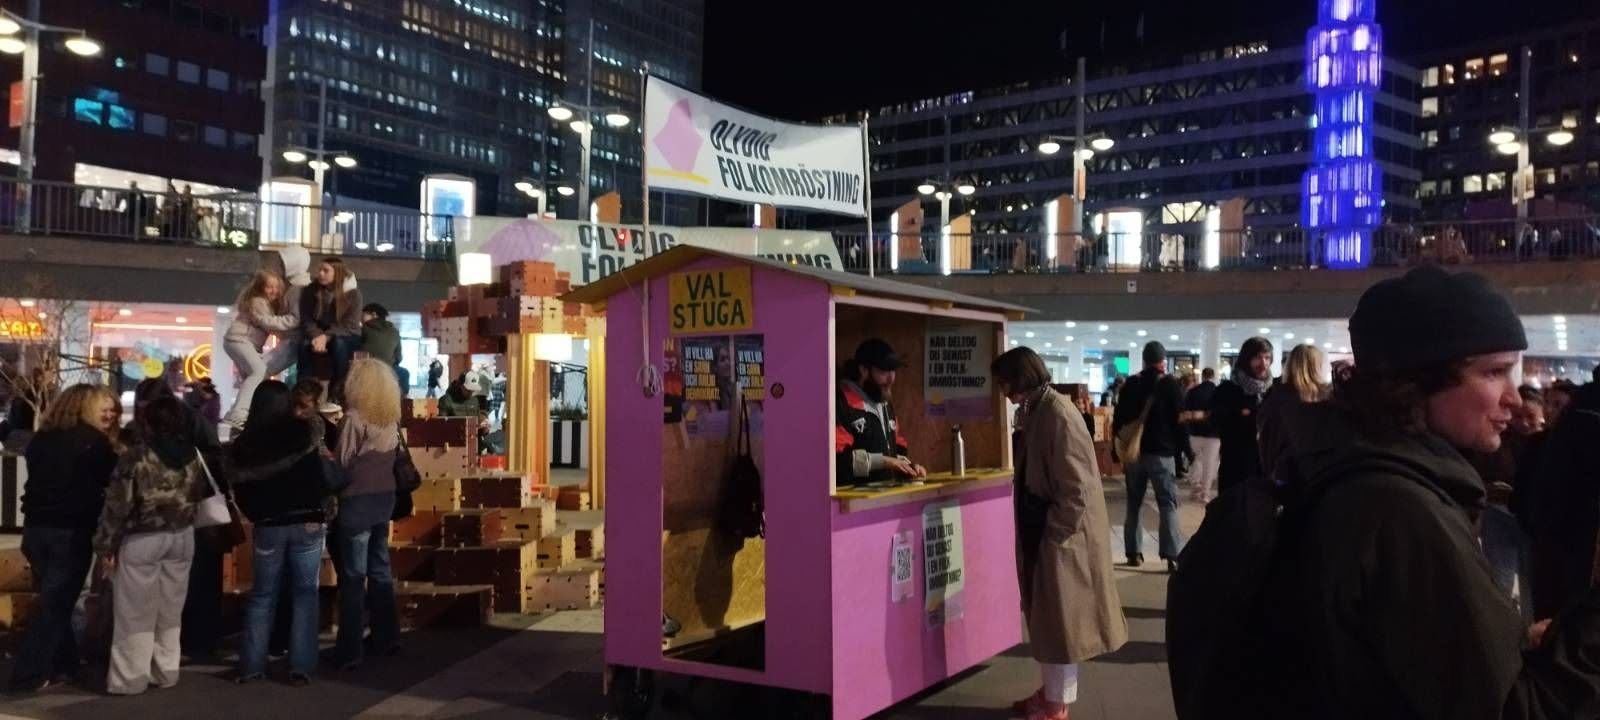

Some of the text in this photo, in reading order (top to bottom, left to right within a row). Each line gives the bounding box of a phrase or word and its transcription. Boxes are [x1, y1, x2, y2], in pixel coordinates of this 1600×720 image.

[710, 119, 777, 162] OLYDIG
[716, 155, 860, 205] FOLKOMRÖSTNING
[686, 271, 732, 300] VAL
[673, 299, 745, 329] STUGA
